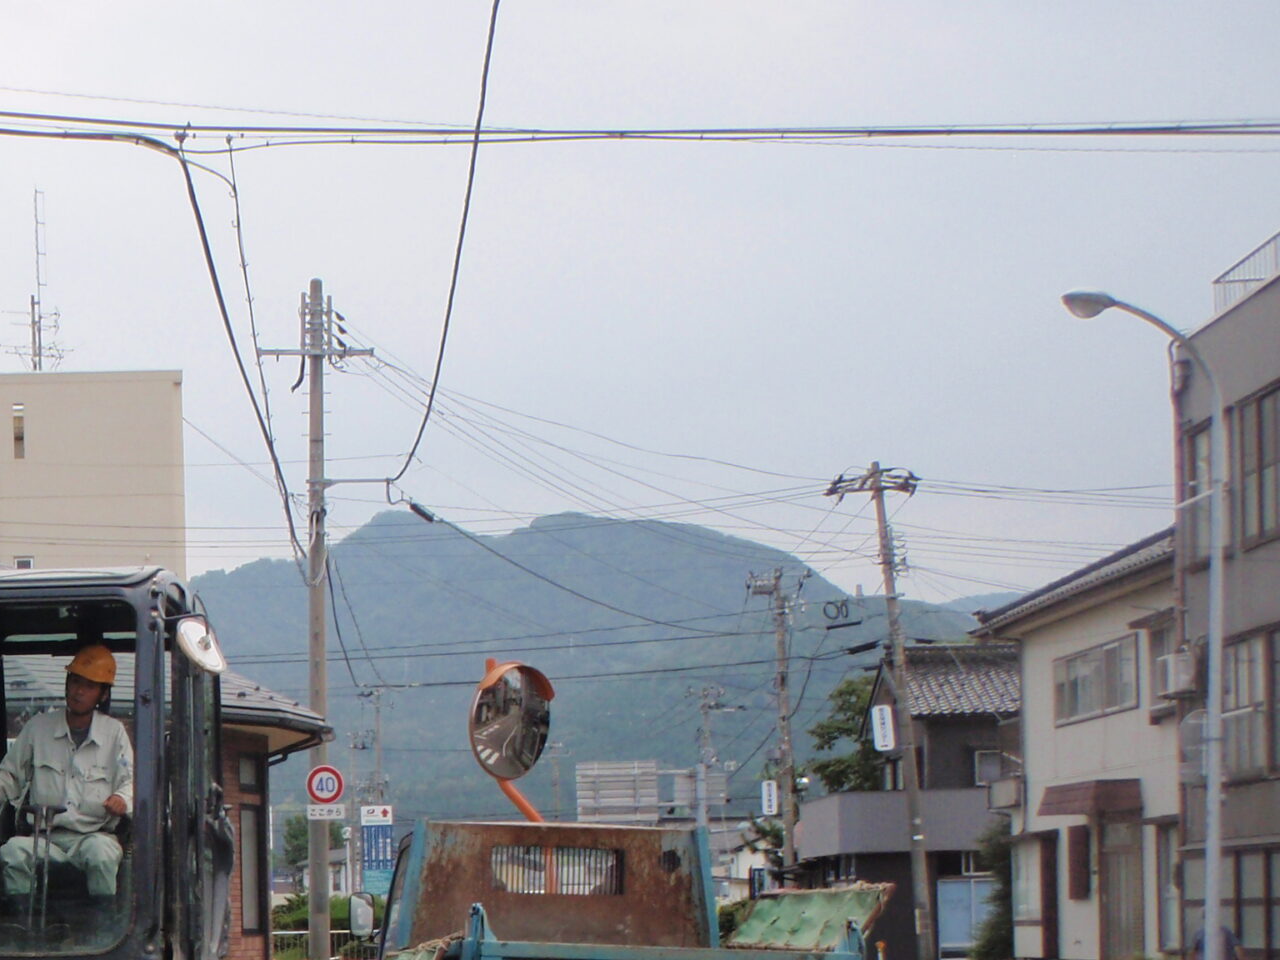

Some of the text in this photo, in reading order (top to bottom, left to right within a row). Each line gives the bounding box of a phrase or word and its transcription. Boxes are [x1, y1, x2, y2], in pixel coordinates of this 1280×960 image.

[315, 776, 336, 793] 40
[310, 807, 342, 817] ここから
